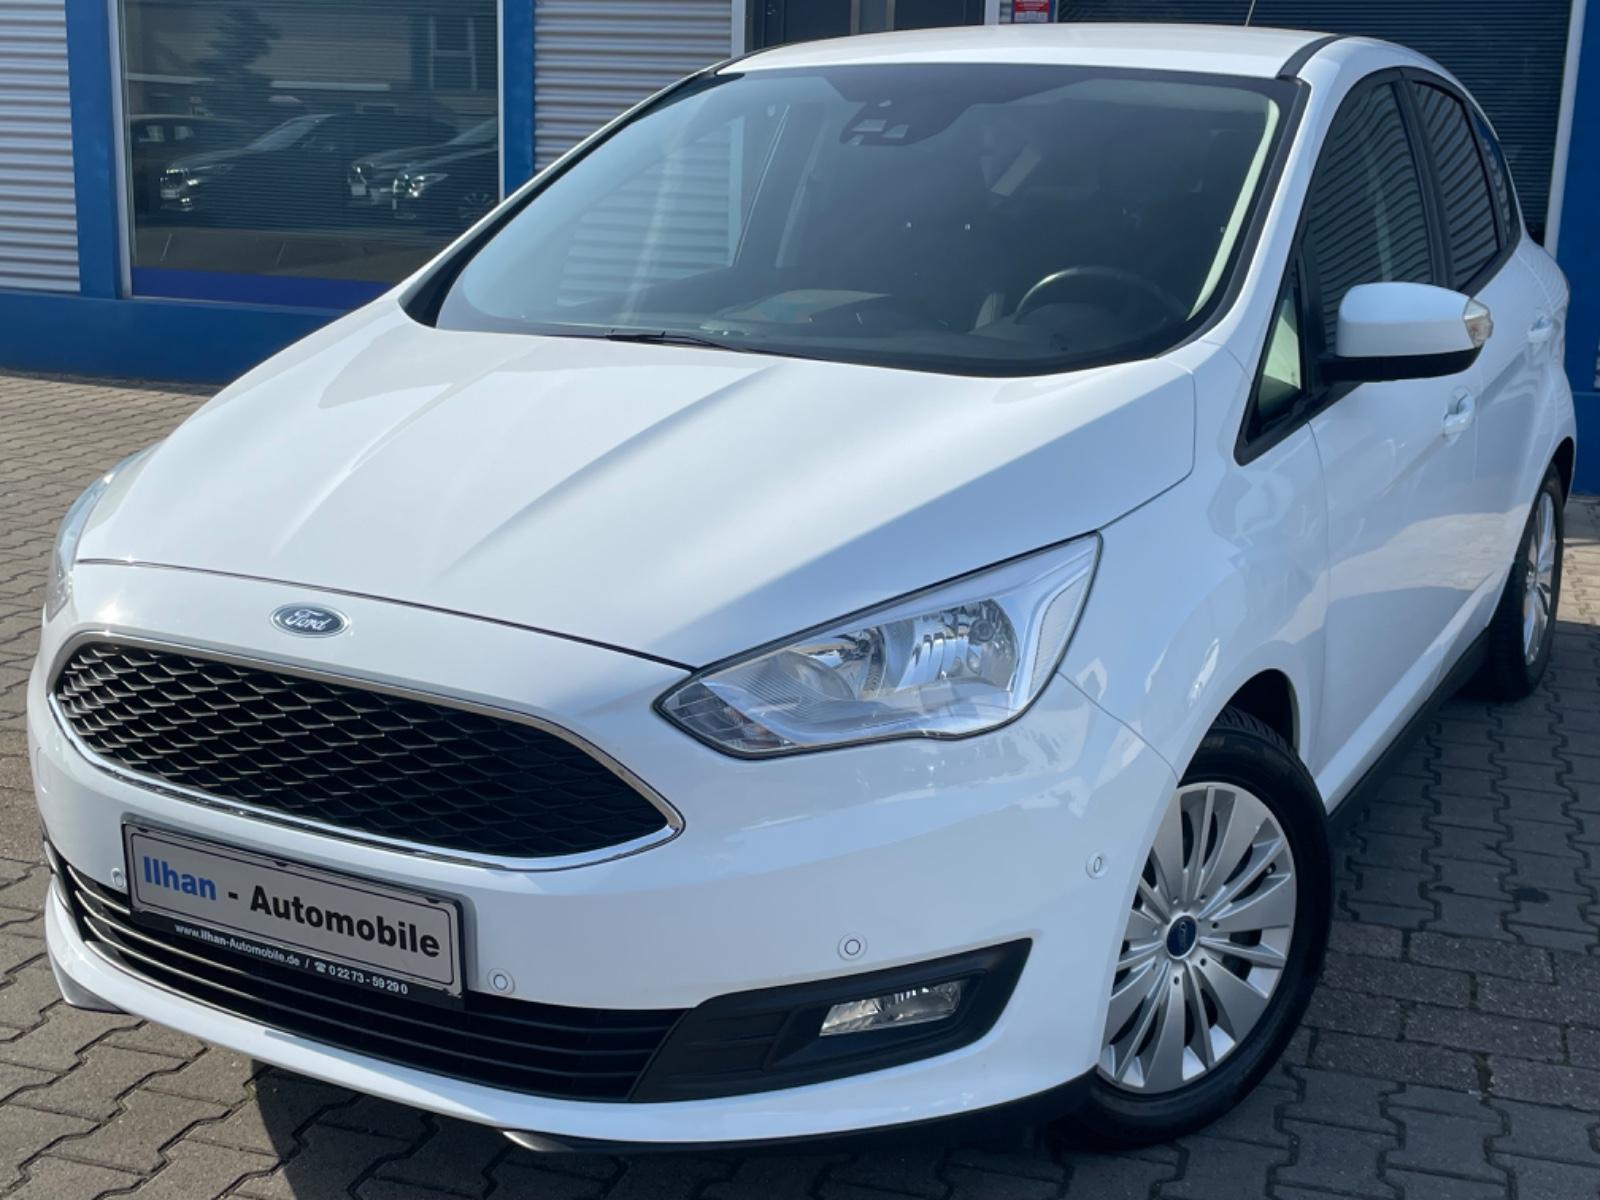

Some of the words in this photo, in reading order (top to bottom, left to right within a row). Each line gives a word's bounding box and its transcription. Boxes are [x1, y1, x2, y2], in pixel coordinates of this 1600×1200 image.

[285, 609, 332, 630] Ford
[143, 855, 217, 900] Ilhan
[250, 885, 440, 957] Automobile
